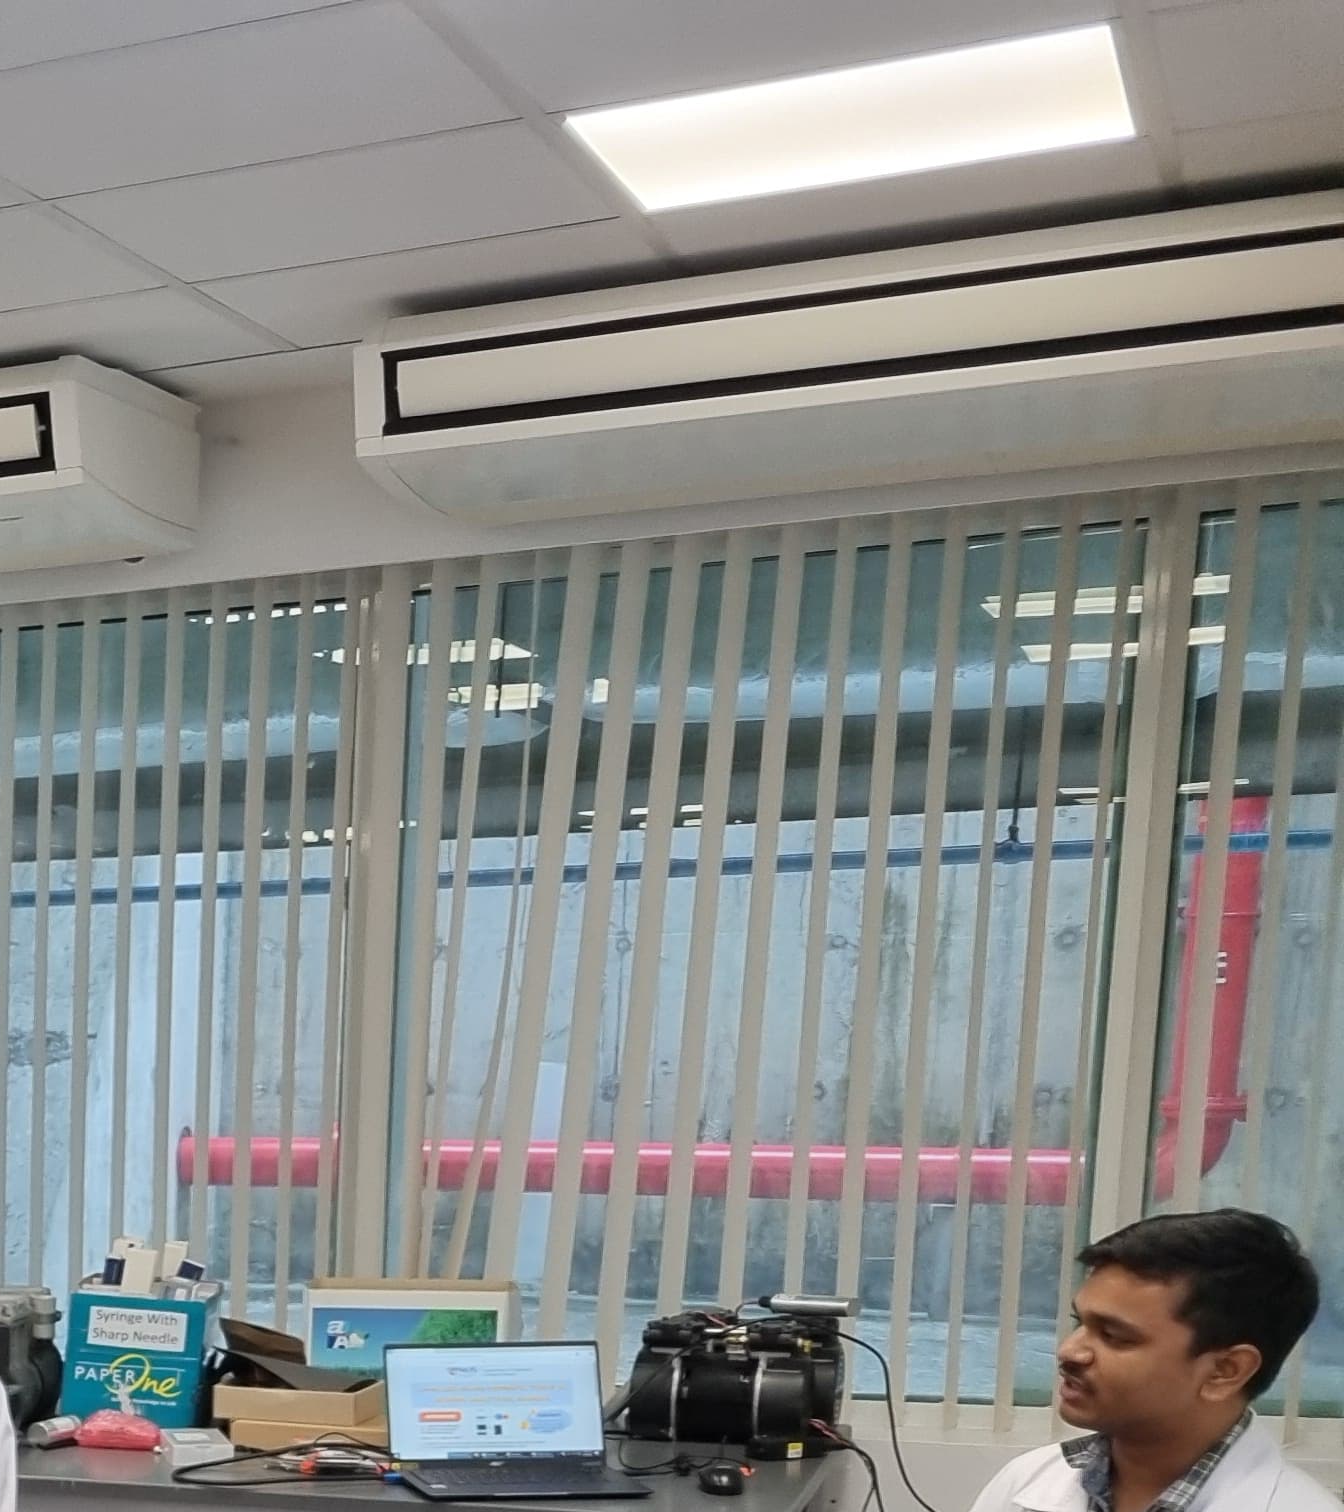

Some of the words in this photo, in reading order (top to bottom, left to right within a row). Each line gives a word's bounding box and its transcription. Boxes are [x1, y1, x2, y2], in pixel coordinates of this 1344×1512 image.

[96, 1309, 143, 1324] Syringe
[147, 1313, 178, 1326] With
[92, 1328, 129, 1343] Sharp
[133, 1331, 179, 1344] Needle
